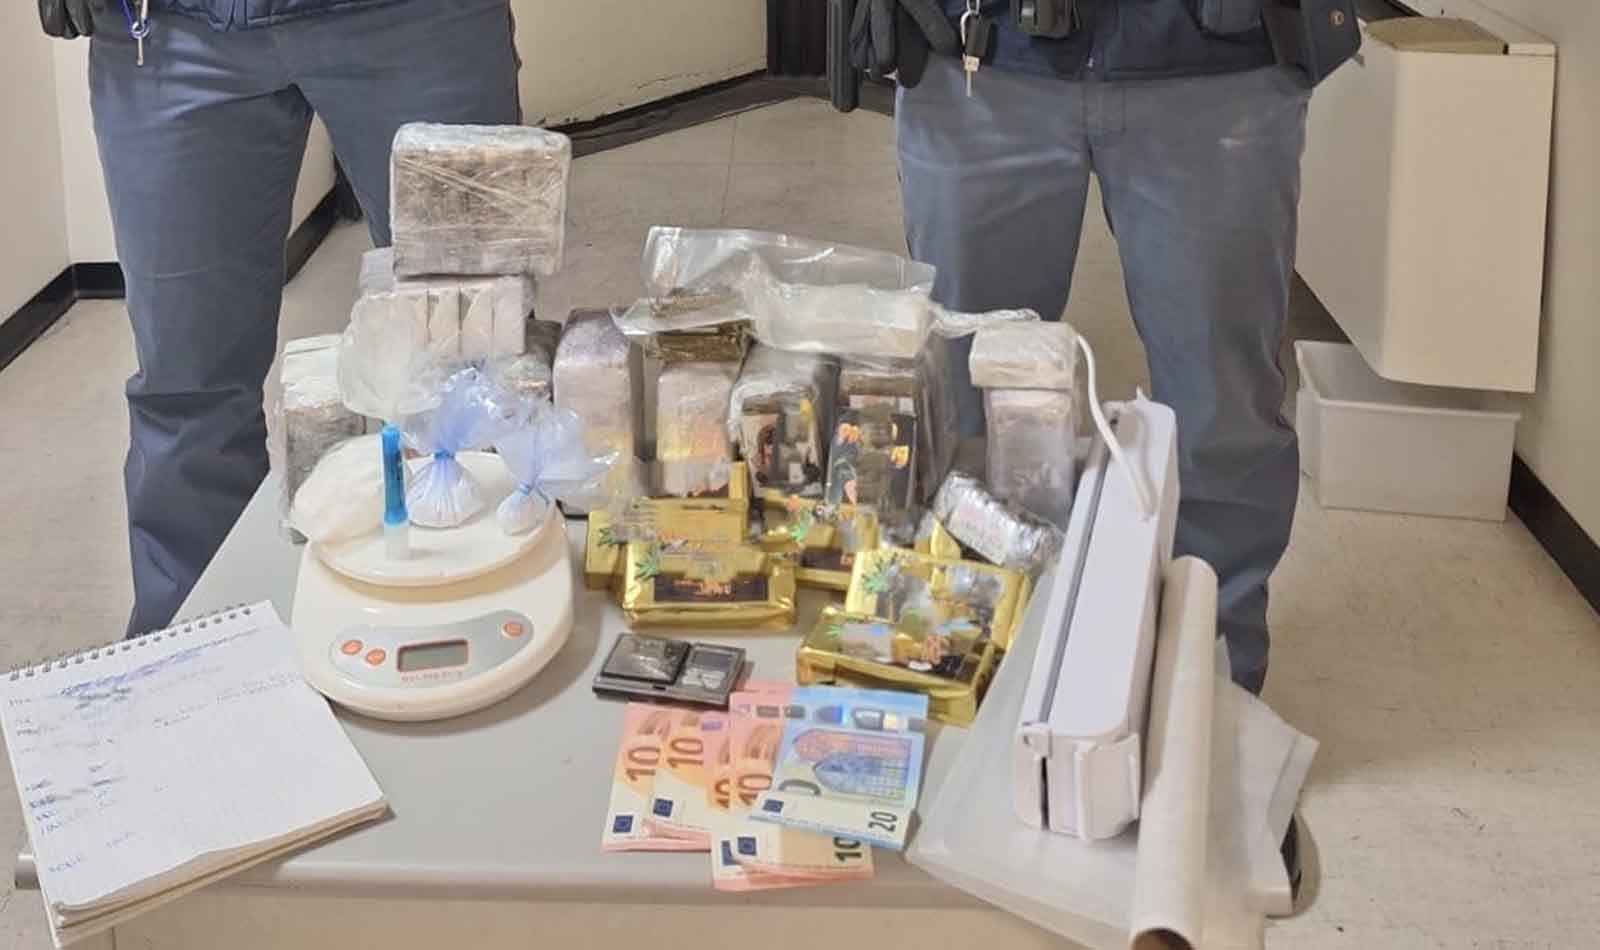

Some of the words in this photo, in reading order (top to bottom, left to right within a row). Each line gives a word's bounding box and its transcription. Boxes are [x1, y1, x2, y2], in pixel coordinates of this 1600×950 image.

[626, 745, 661, 781] 10
[665, 737, 704, 768] 10
[738, 774, 773, 806] 10
[867, 811, 898, 832] 20
[832, 836, 863, 862] 10
